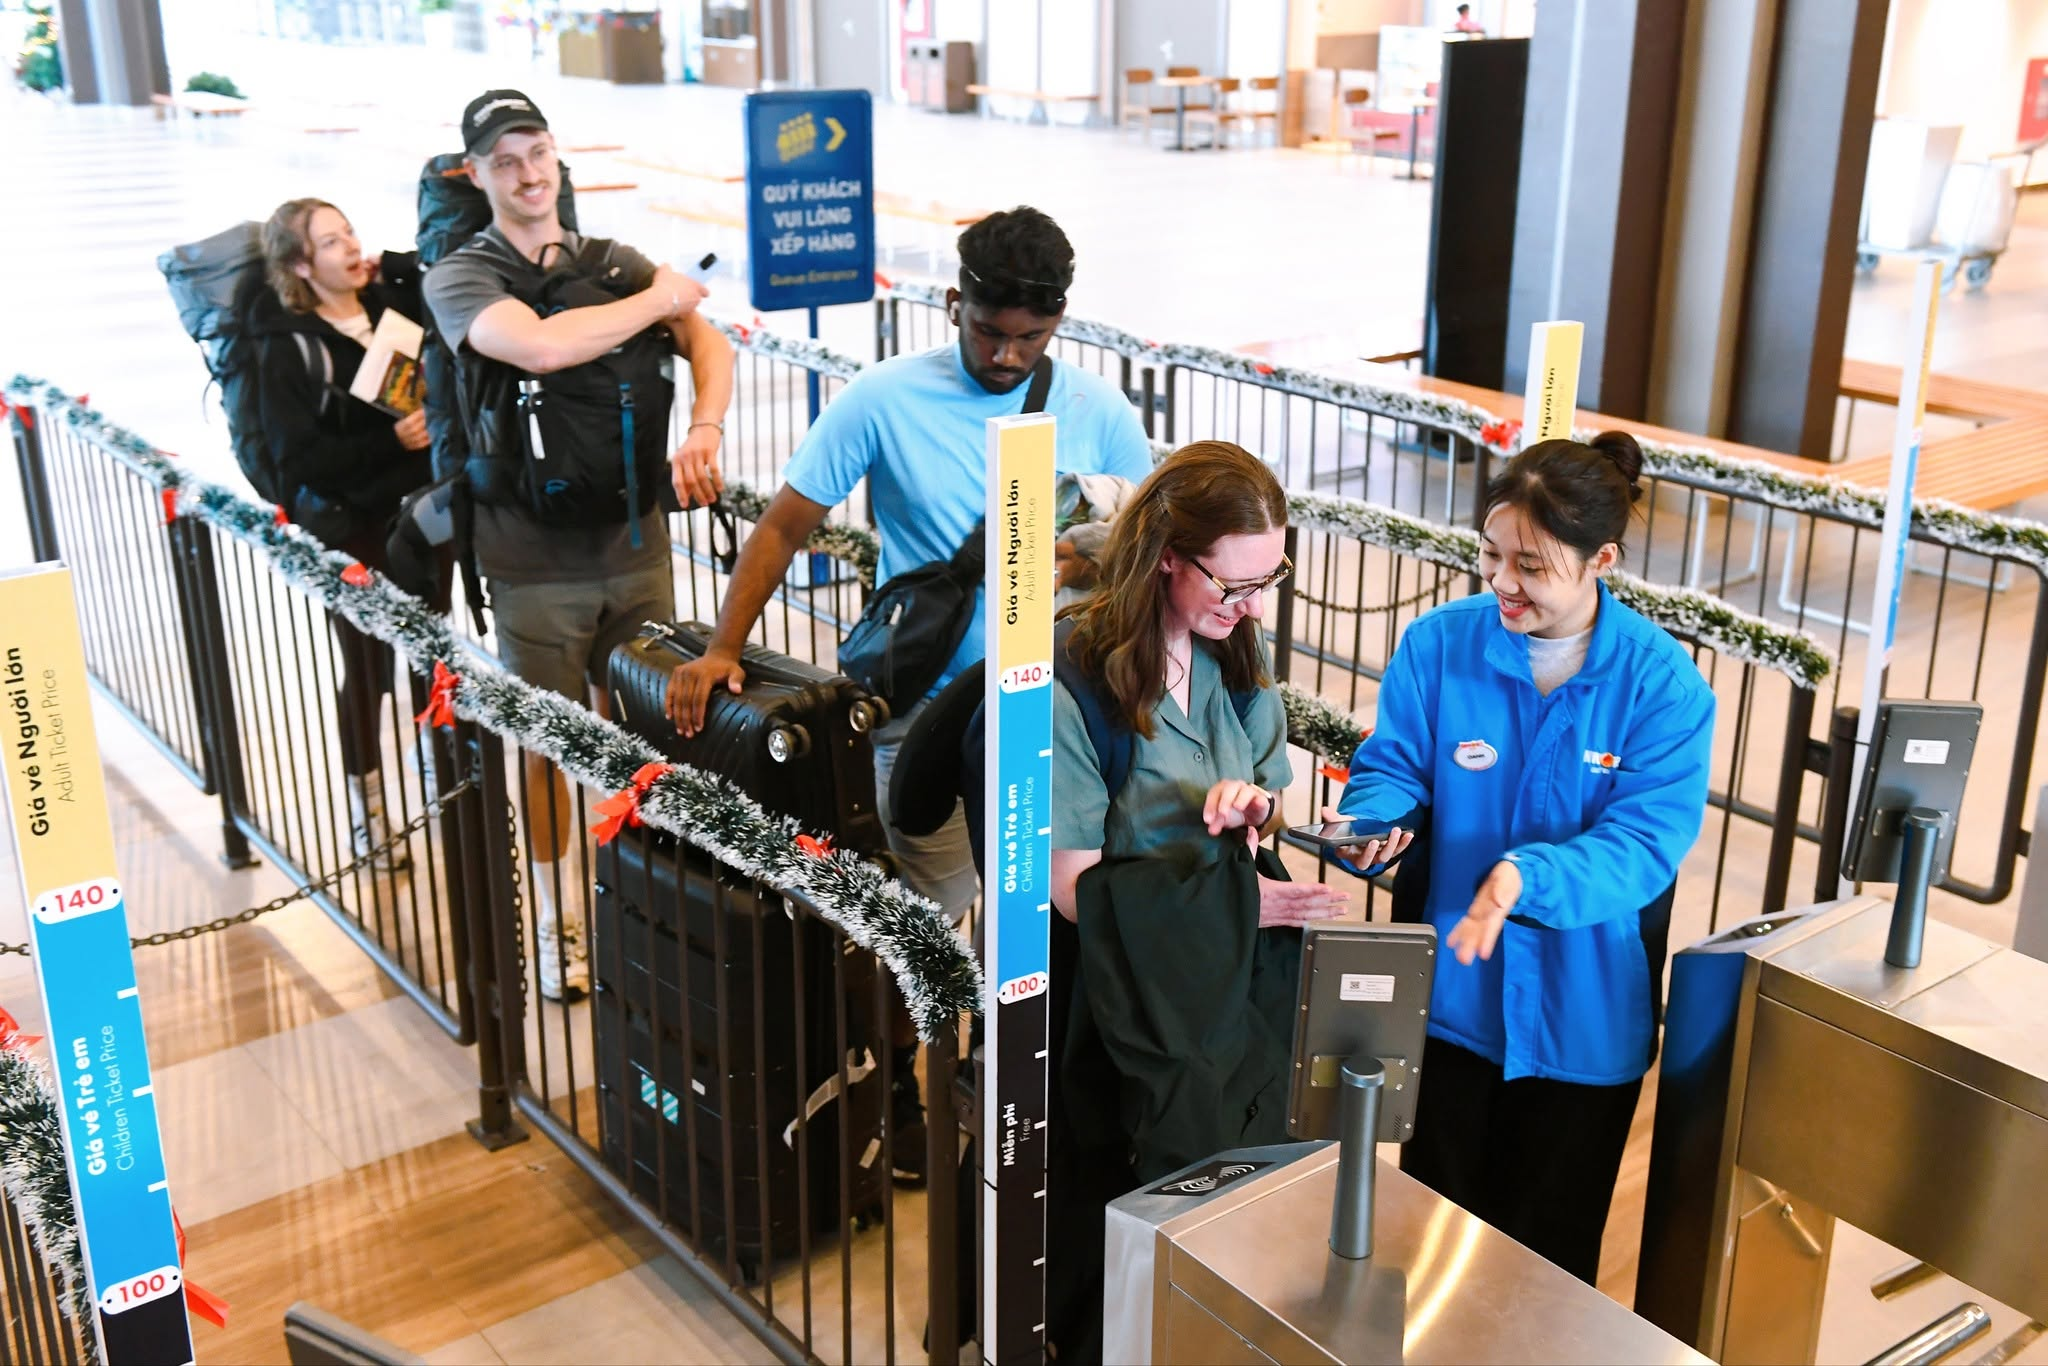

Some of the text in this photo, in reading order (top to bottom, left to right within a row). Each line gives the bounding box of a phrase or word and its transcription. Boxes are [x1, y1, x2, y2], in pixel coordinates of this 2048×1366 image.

[763, 177, 861, 203] QUÝ KHÁCH
[772, 203, 852, 228] VUI LÒNG
[770, 230, 856, 255] XẾP HÀNG
[1006, 479, 1021, 625] Giá vé Người lớn
[1024, 497, 1036, 601] Adult Ticket Price
[1013, 666, 1041, 686] 140
[4, 647, 50, 837] Giá vé Người lớn
[40, 669, 75, 802] Adult Ticket Price
[1007, 784, 1017, 809] em
[1021, 776, 1034, 892] Children Ticket Price
[1005, 841, 1017, 861] vé
[1004, 864, 1017, 893] Giá
[55, 885, 104, 913] 140
[1010, 976, 1039, 995] 100
[72, 1037, 107, 1176] Giá vé Trẻ em
[99, 1025, 135, 1171] Children Ticket Price
[1002, 1103, 1018, 1127] phí
[1019, 1117, 1031, 1142] Free
[118, 1272, 165, 1304] 100
